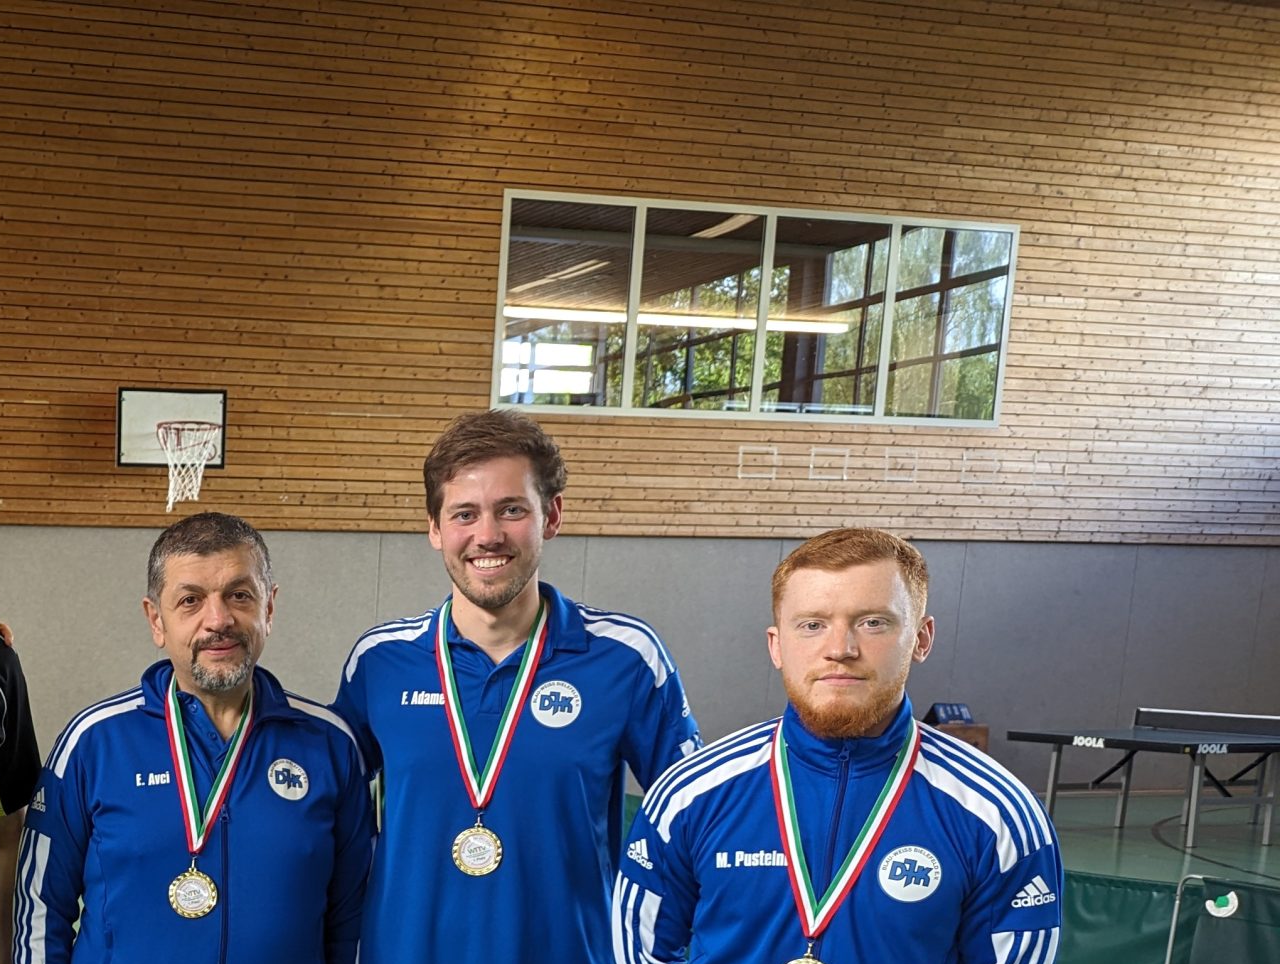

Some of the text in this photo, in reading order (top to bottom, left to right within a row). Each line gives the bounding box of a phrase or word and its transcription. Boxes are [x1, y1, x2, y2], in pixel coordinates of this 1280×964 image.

[401, 691, 409, 706] F.
[1072, 735, 1104, 749] JOOLA
[1196, 743, 1228, 755] JOOLA
[135, 770, 171, 787] E. Avci
[716, 852, 732, 869] M.
[1011, 893, 1056, 908] adidas
